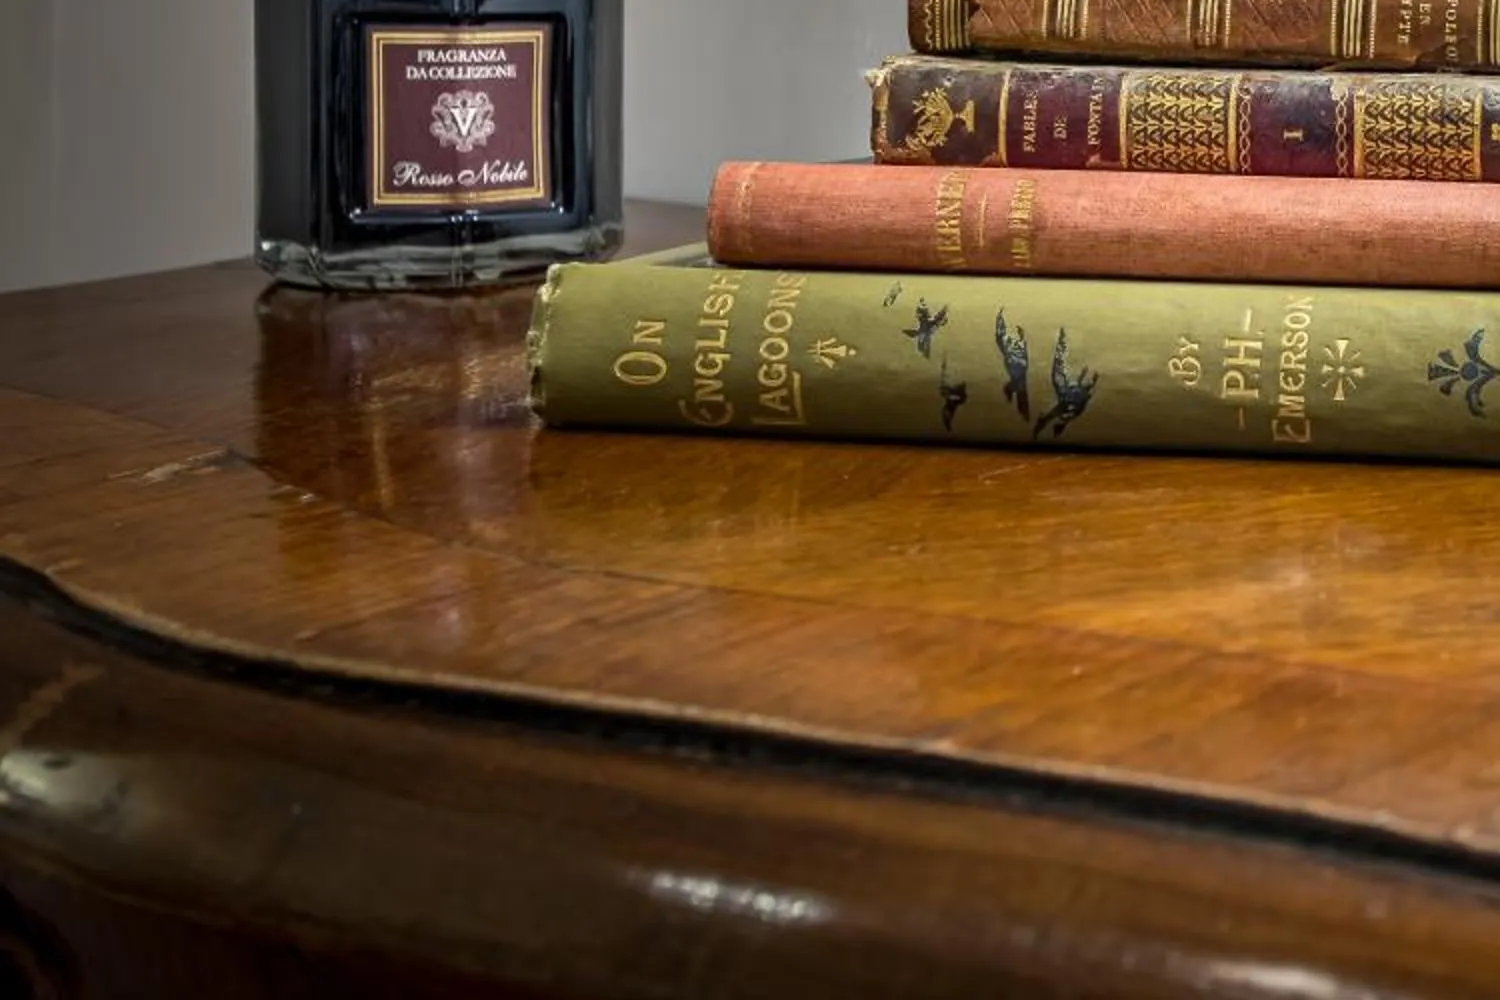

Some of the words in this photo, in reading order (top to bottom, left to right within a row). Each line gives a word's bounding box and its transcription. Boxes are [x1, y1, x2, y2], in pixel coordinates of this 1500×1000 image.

[417, 47, 507, 64] FRAGRANZA
[406, 66, 428, 80] DA
[429, 64, 518, 81] COLLEZIONE
[392, 161, 453, 188] Rosso
[457, 159, 529, 187] Nobile
